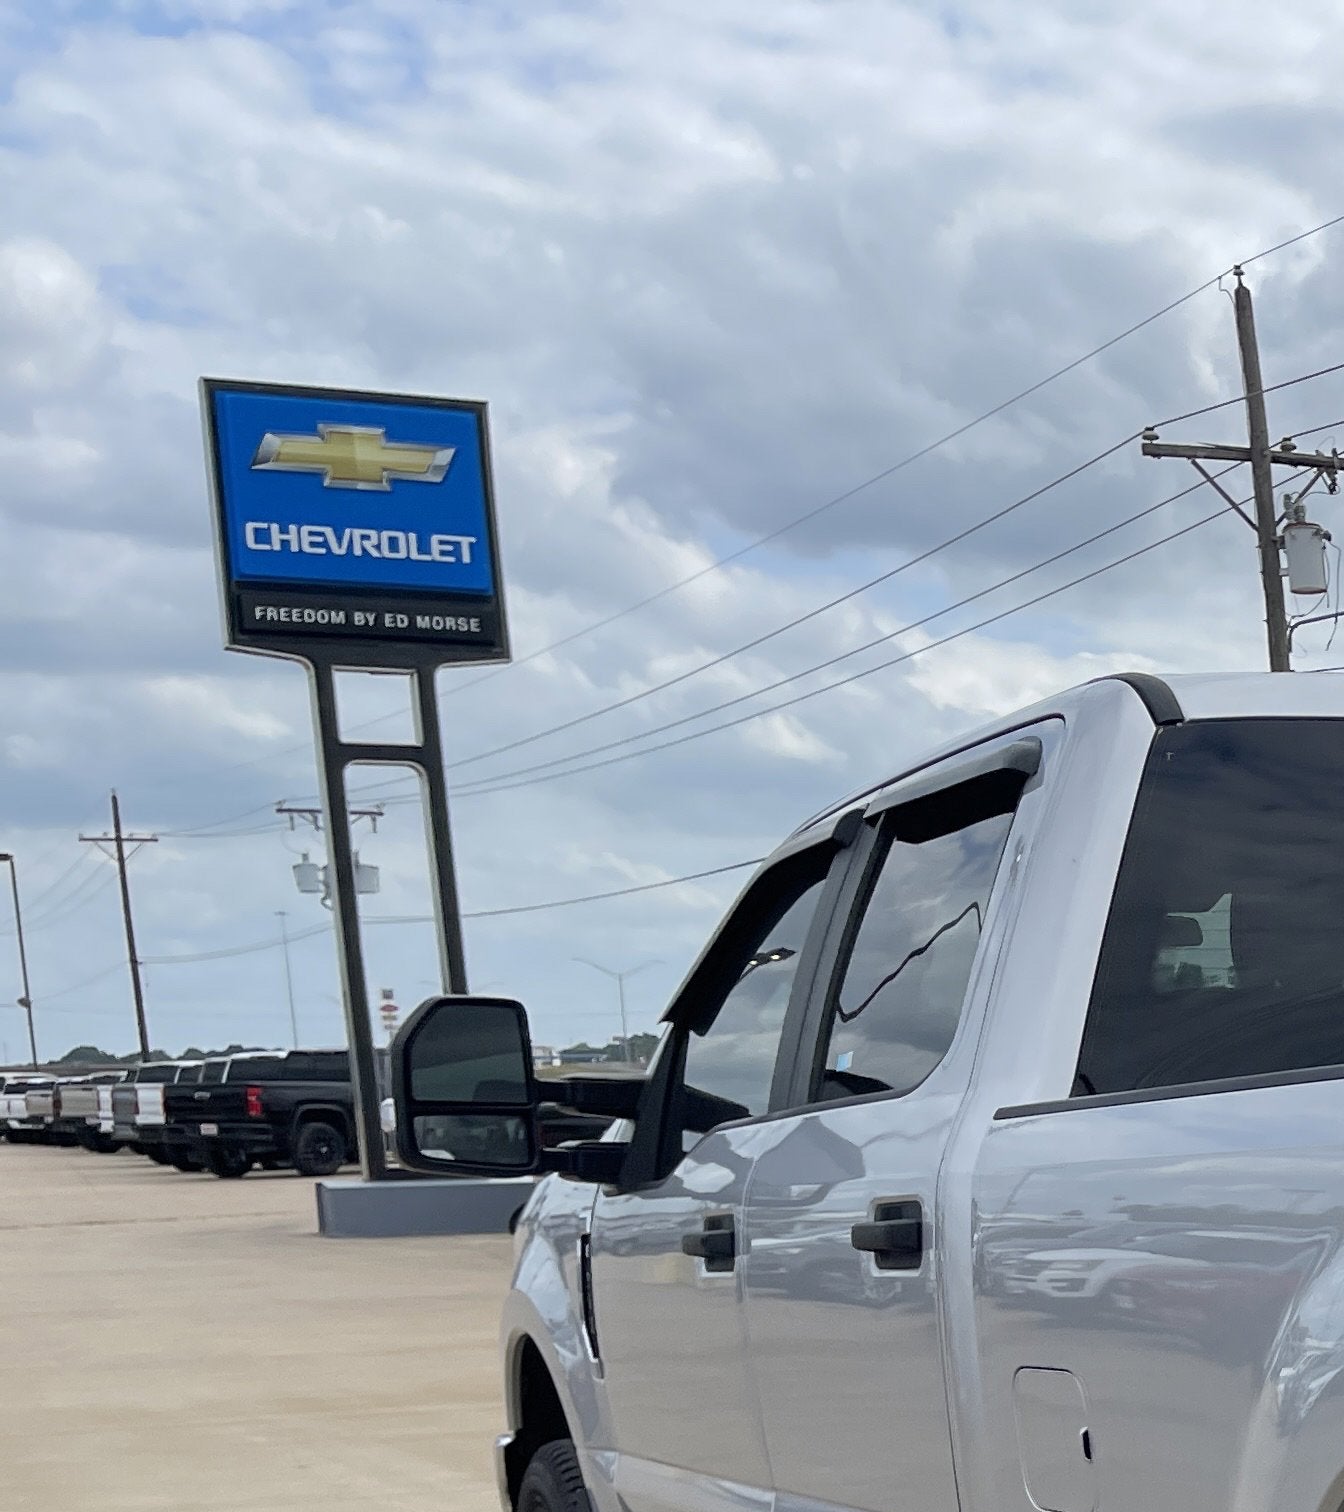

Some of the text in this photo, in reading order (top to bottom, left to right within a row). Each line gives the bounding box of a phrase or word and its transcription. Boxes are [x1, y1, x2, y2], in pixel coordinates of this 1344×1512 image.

[245, 521, 477, 564] CHEVROLET
[254, 606, 481, 632] FREEDOM BY ED MORSE
